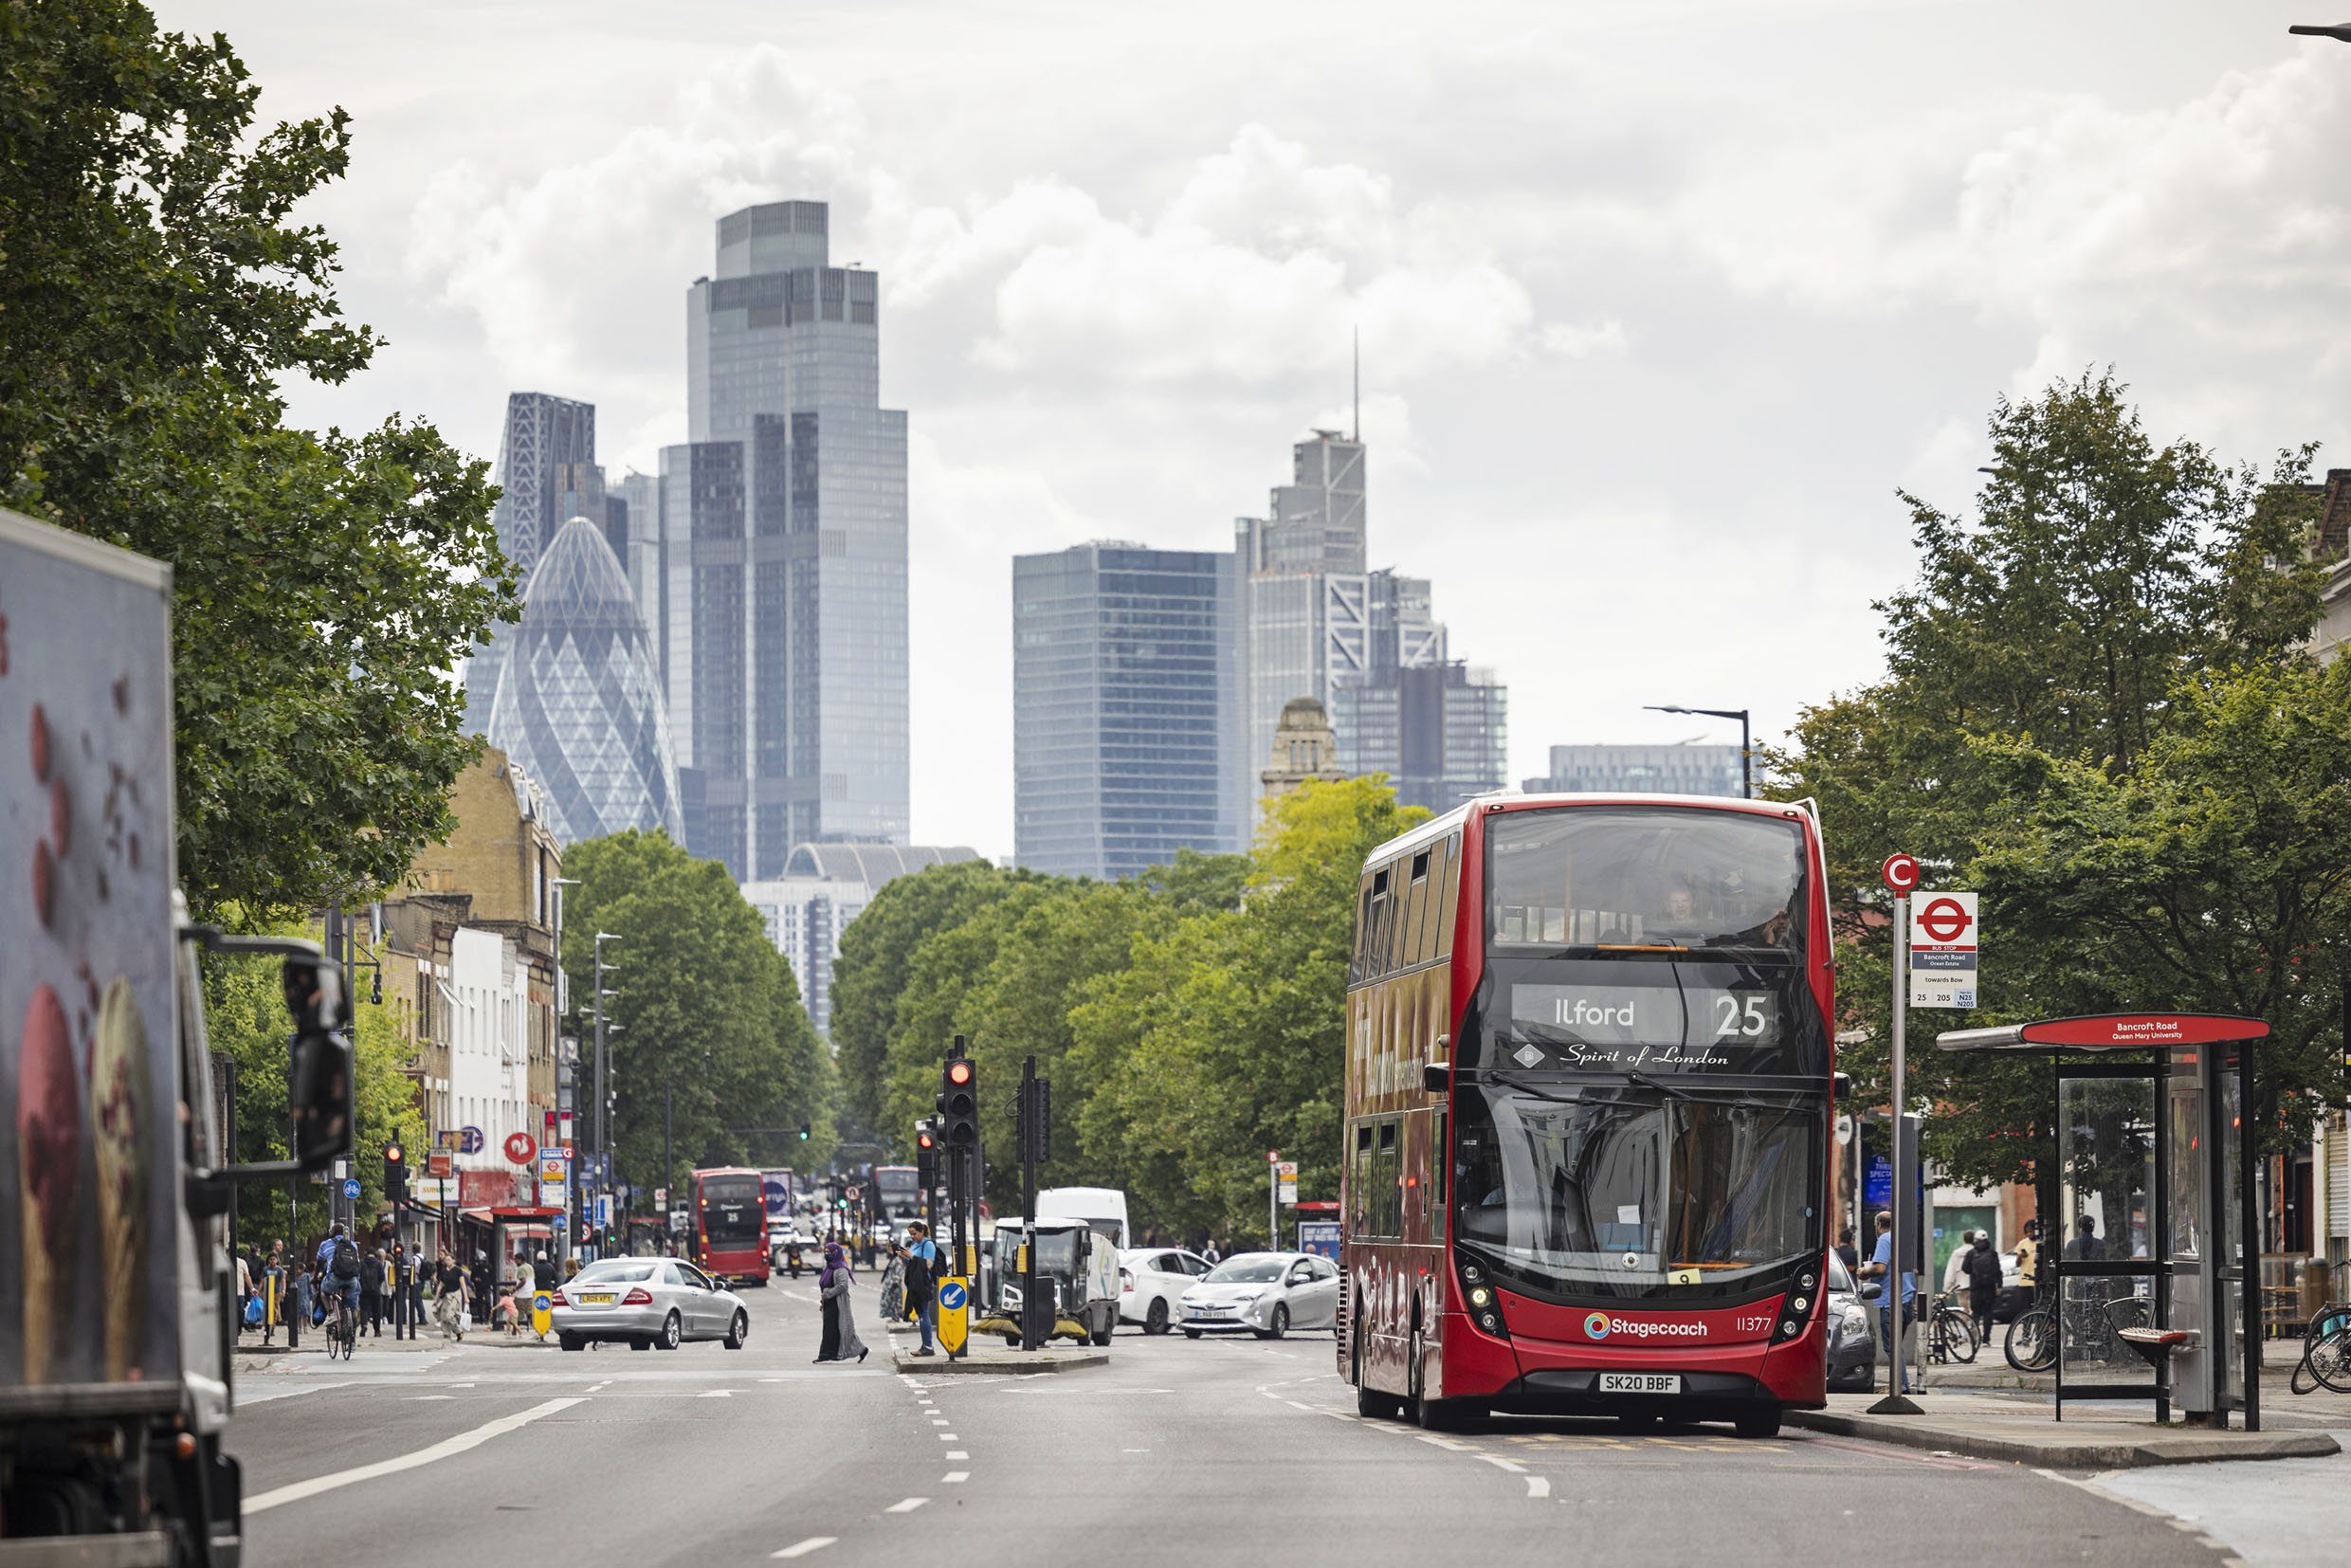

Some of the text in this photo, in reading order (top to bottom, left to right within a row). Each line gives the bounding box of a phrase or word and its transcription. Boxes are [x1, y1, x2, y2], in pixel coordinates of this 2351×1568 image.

[1888, 859, 1911, 885] C
[1937, 994, 1951, 1002] 205
[1555, 998, 1634, 1026] Ilford
[1716, 996, 1767, 1036] 25
[2117, 1021, 2178, 1031] Bancroft Road
[1559, 1043, 1729, 1066] Spirit of London
[563, 1148, 573, 1158] G
[727, 1212, 738, 1222] 25
[1612, 1319, 1707, 1338] Stagecoach
[1737, 1317, 1772, 1331] 11377
[1606, 1376, 1674, 1391] SK20 BBF
